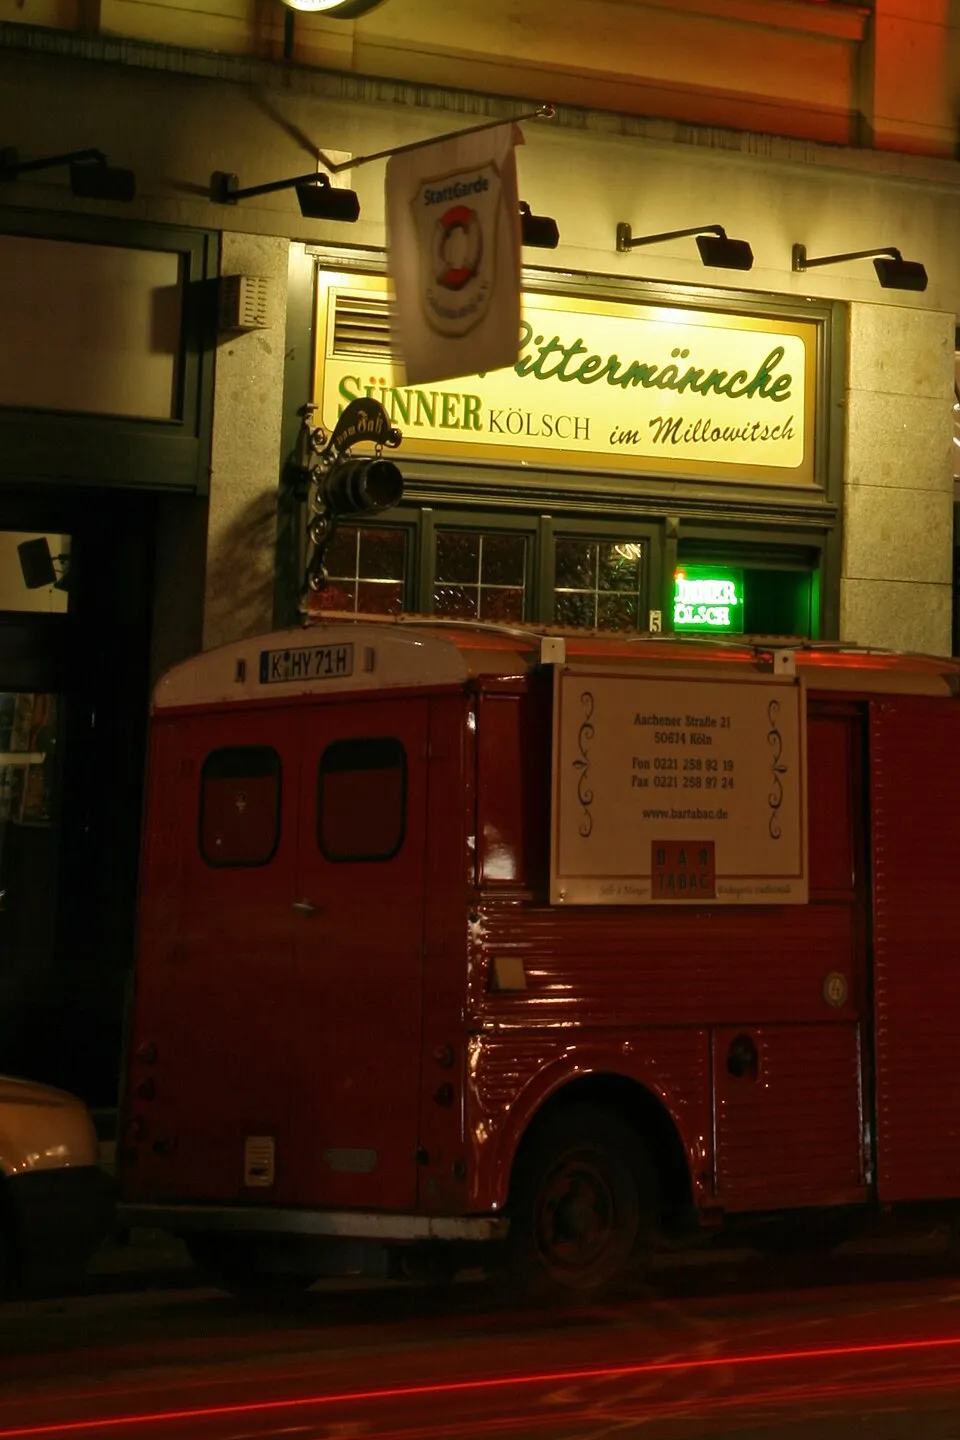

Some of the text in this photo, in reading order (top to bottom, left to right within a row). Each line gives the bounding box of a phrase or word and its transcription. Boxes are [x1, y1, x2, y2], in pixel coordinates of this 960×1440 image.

[488, 407, 592, 440] KÖLSCH
[609, 415, 795, 446] im Millowitsch
[633, 713, 731, 729] Aachener Straße 21
[654, 731, 713, 746] 50674 Köln
[631, 756, 651, 770] Fon
[653, 757, 678, 771] 0221
[682, 758, 703, 771] 258
[631, 774, 650, 788] Fax
[653, 775, 678, 788] 0221
[705, 776, 718, 790] 97
[720, 776, 735, 790] 24
[642, 807, 729, 820] www.bartabac.de
[657, 871, 709, 891] TABAC
